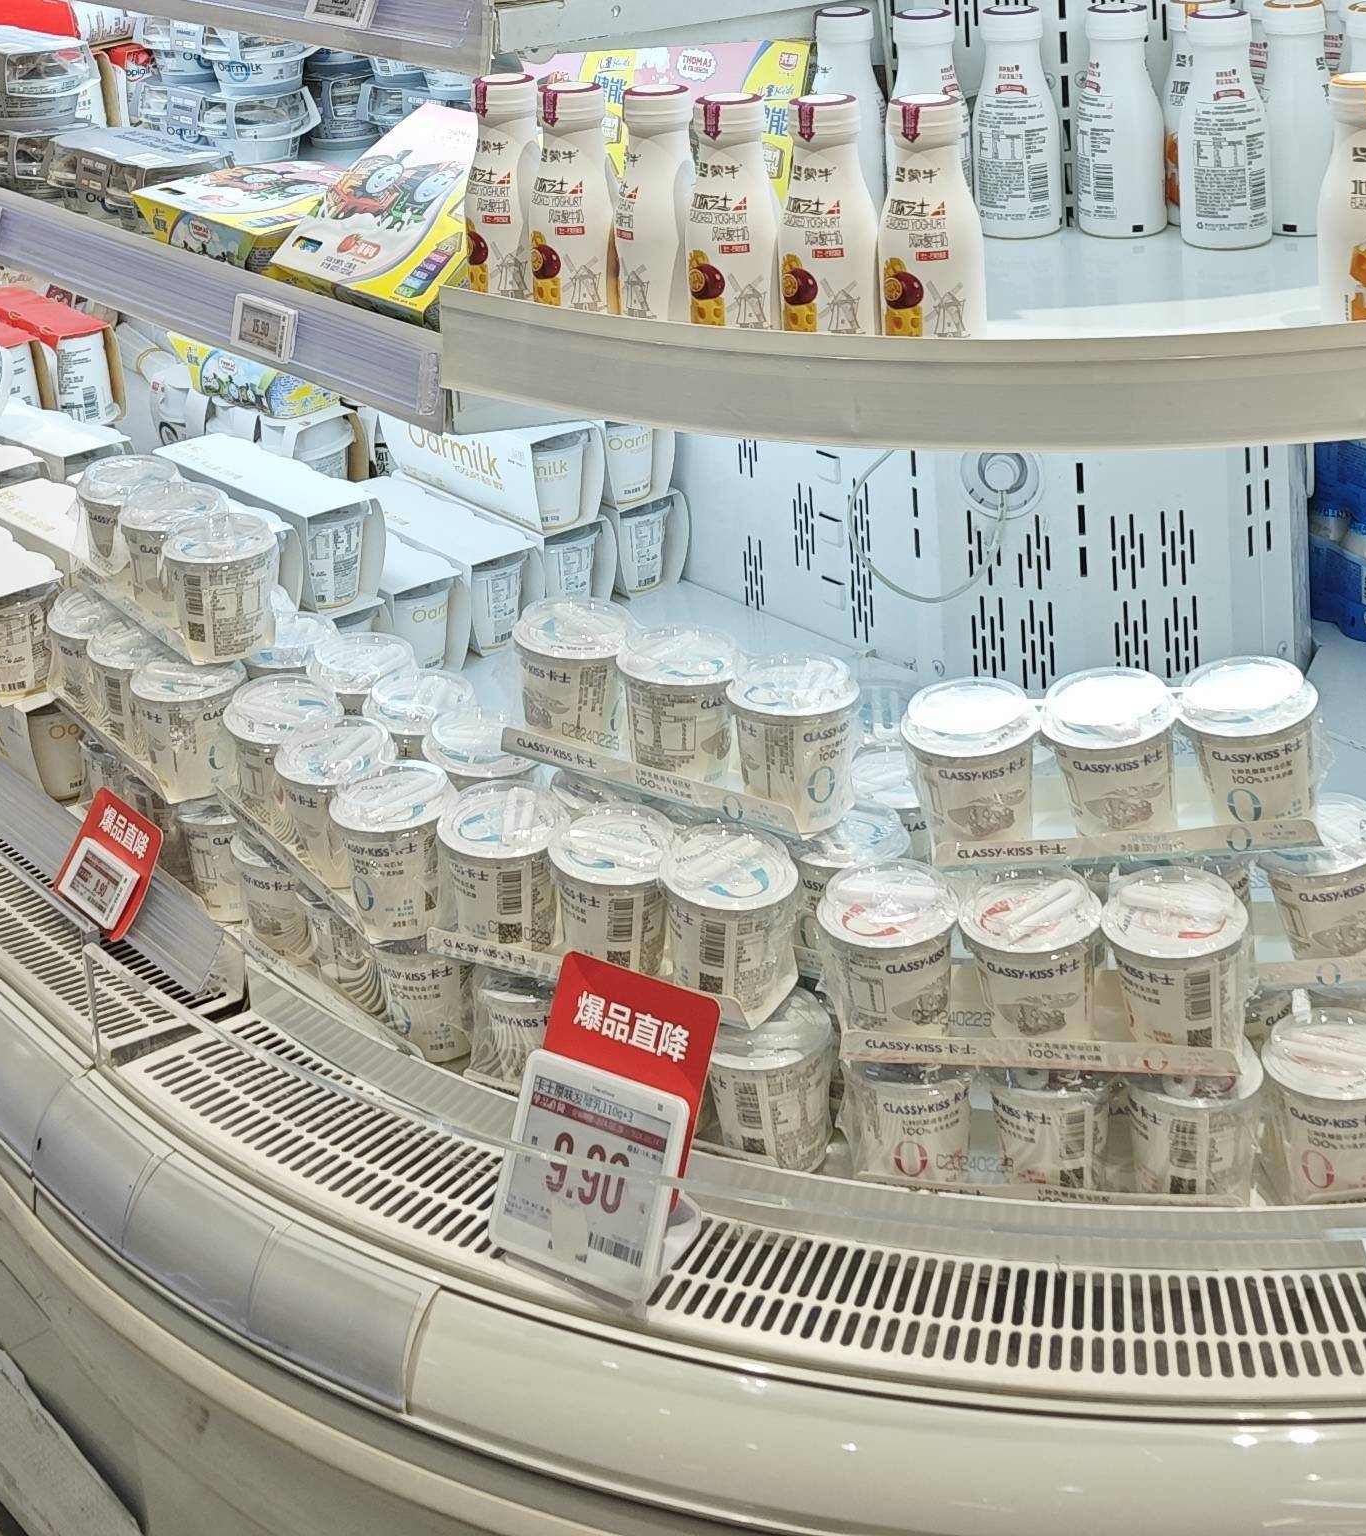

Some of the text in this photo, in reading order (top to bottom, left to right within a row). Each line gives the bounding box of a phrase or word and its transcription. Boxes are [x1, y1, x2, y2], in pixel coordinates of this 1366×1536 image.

[682, 54, 713, 66] THOMAS
[97, 804, 148, 859] 爆品直降
[573, 991, 689, 1061] 爆品直降
